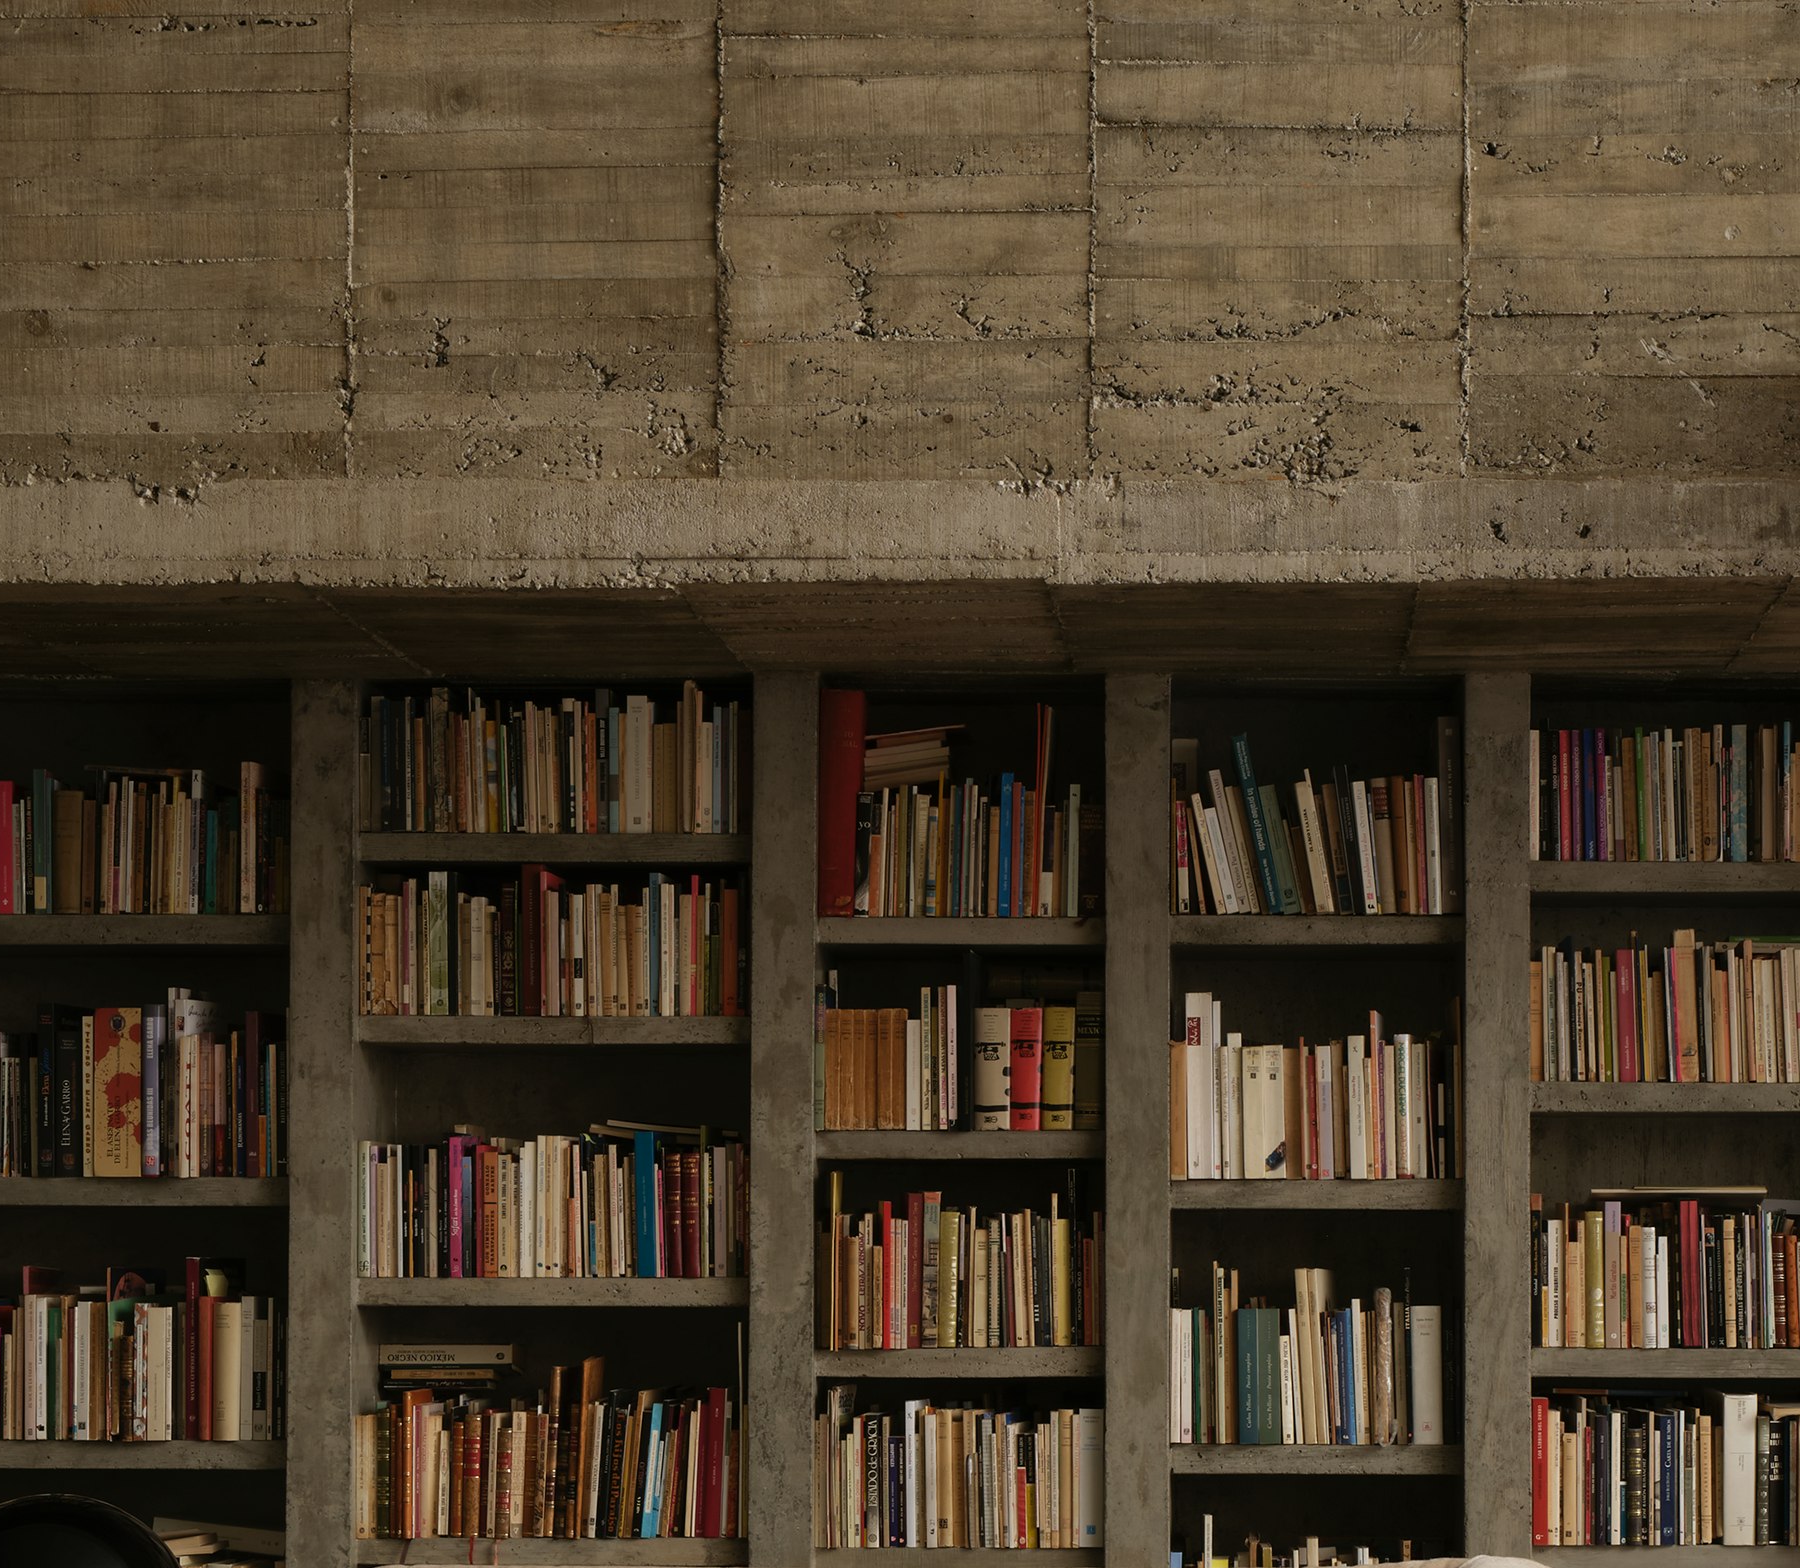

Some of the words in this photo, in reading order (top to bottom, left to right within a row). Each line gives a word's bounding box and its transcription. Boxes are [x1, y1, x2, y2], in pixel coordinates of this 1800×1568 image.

[857, 821, 871, 831] yo
[1249, 796, 1260, 818] praise
[1255, 829, 1267, 851] hands
[106, 1103, 114, 1145] ASESINATO
[106, 1148, 114, 1157] EL
[114, 1154, 121, 1164] DE
[451, 1218, 460, 1236] Safari
[387, 1353, 418, 1362] NEGRO
[867, 1420, 877, 1456] GRACIA
[867, 1457, 877, 1469] de
[1664, 1450, 1672, 1467] CARTA
[867, 1471, 878, 1506] ESTADO
